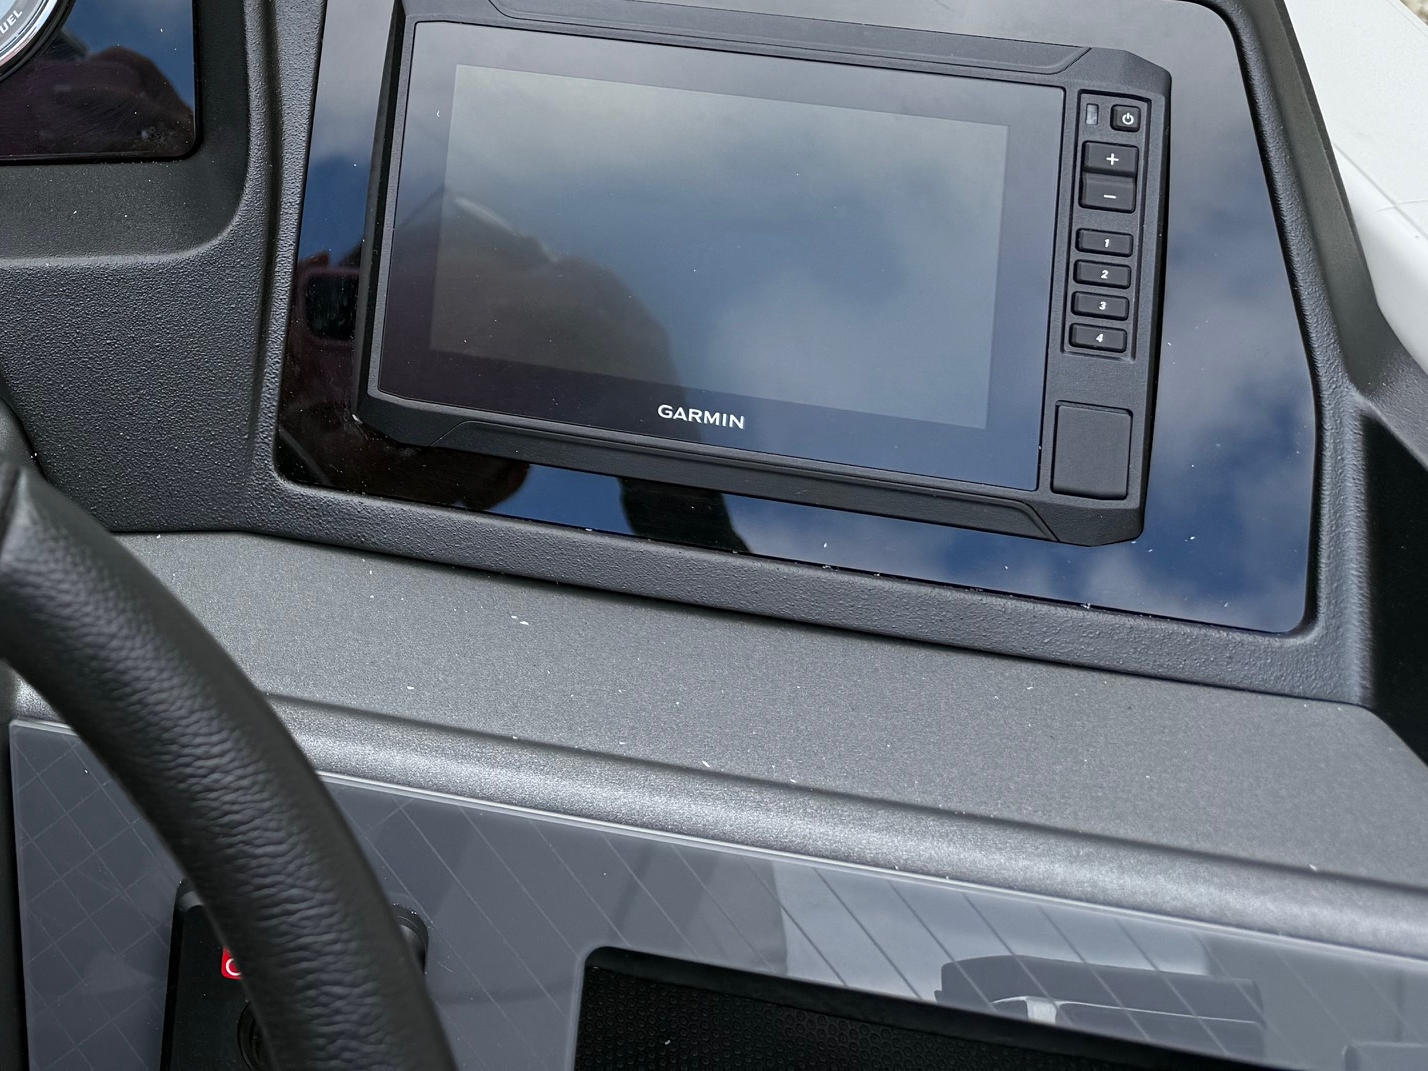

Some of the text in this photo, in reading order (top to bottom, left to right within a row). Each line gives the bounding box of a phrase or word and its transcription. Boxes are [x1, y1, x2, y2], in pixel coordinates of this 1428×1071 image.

[1104, 238, 1110, 248] 1
[1100, 270, 1109, 279] 2
[1098, 301, 1107, 310] 3
[1095, 333, 1104, 342] 4
[657, 404, 745, 430] GARMIN
